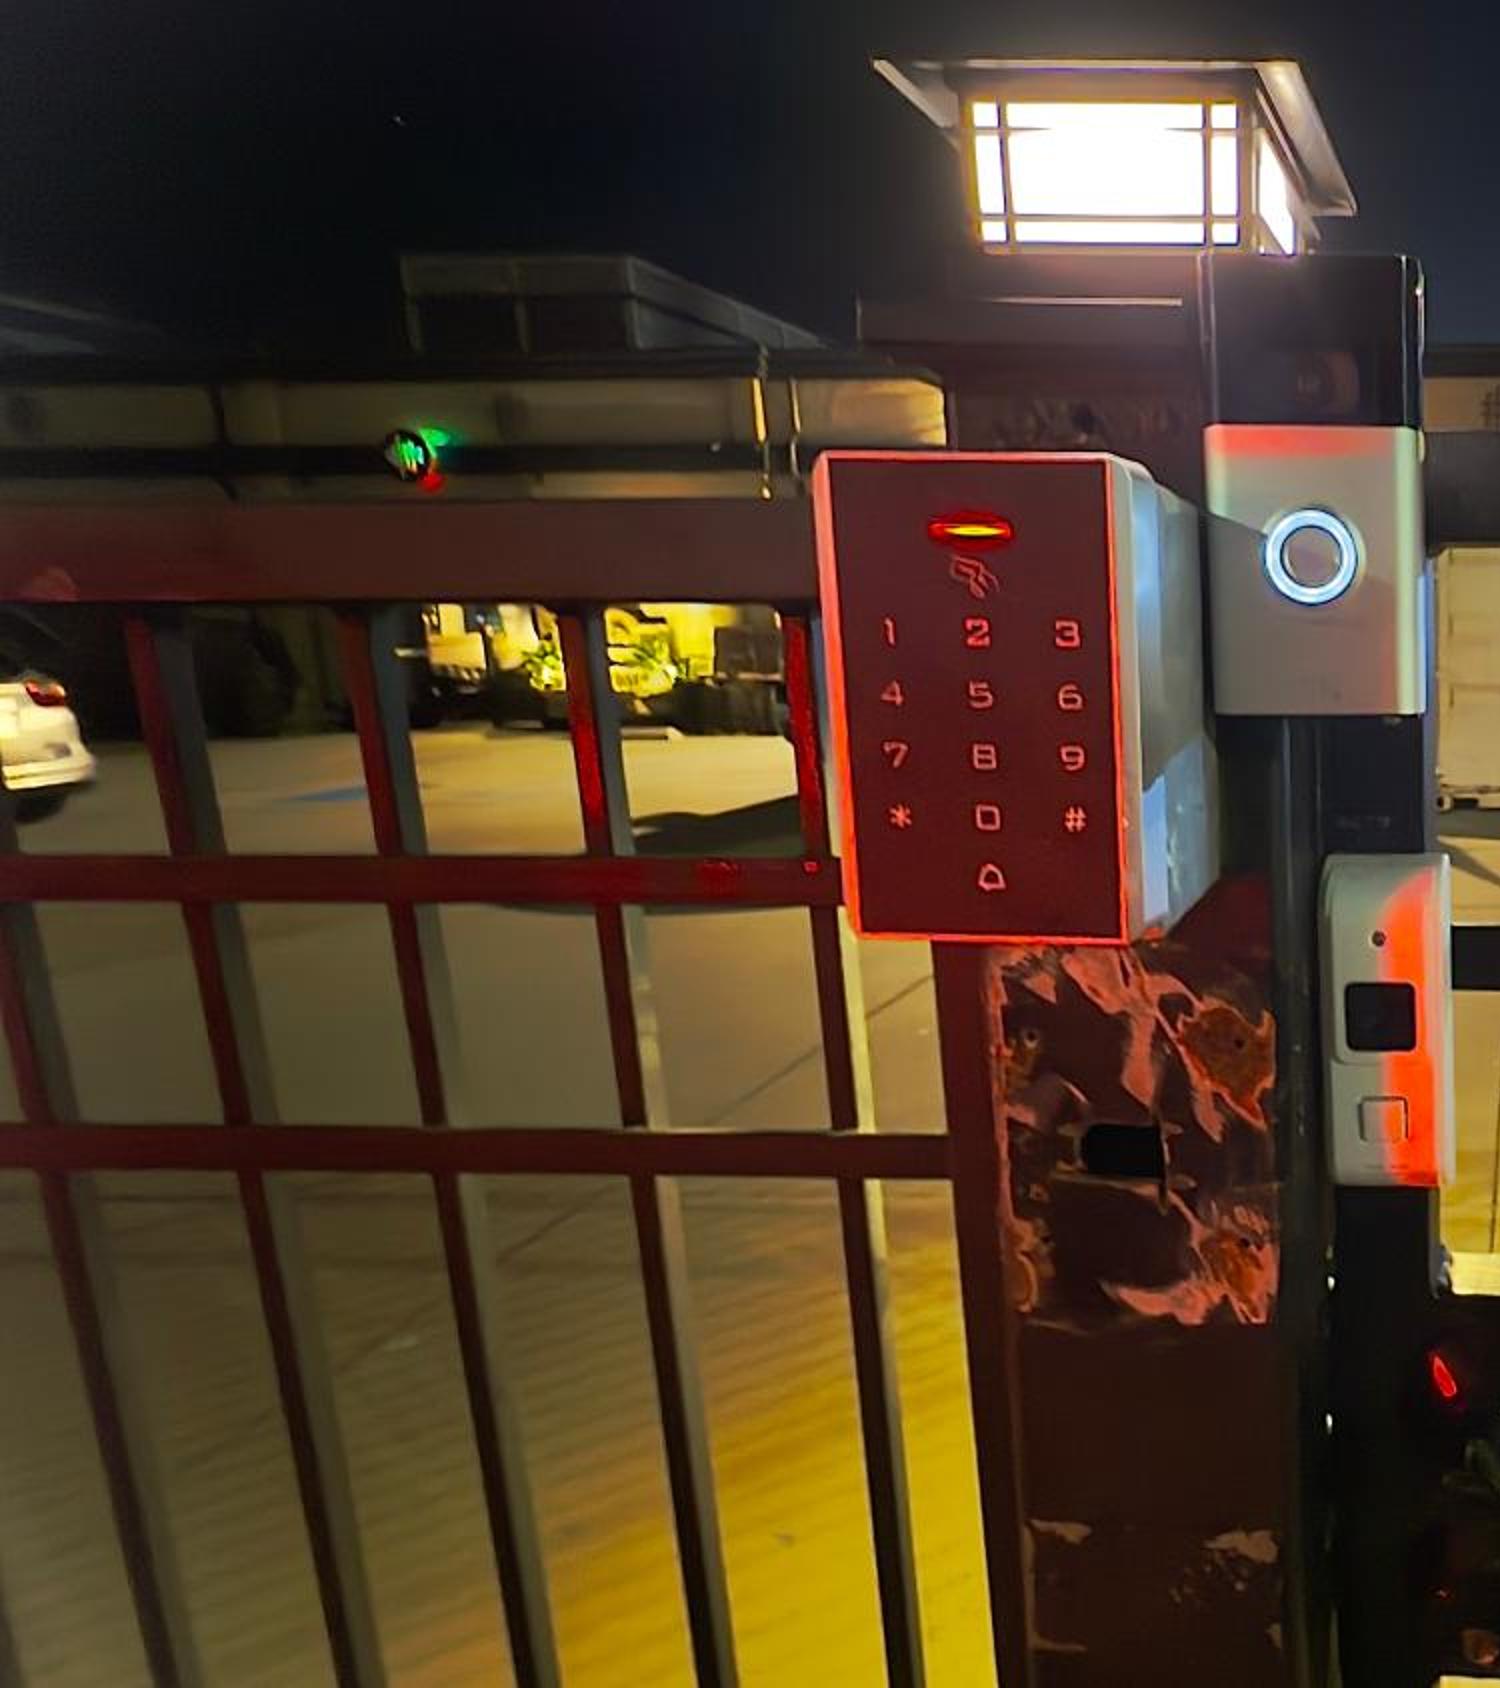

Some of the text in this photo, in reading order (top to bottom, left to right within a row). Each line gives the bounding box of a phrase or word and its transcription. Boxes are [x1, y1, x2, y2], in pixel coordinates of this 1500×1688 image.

[884, 618, 1081, 647] 1 2 3
[881, 681, 1083, 710] 4 5 6
[883, 742, 1085, 771] 7 8 9
[975, 804, 1001, 831] 0
[1065, 807, 1086, 832] #
